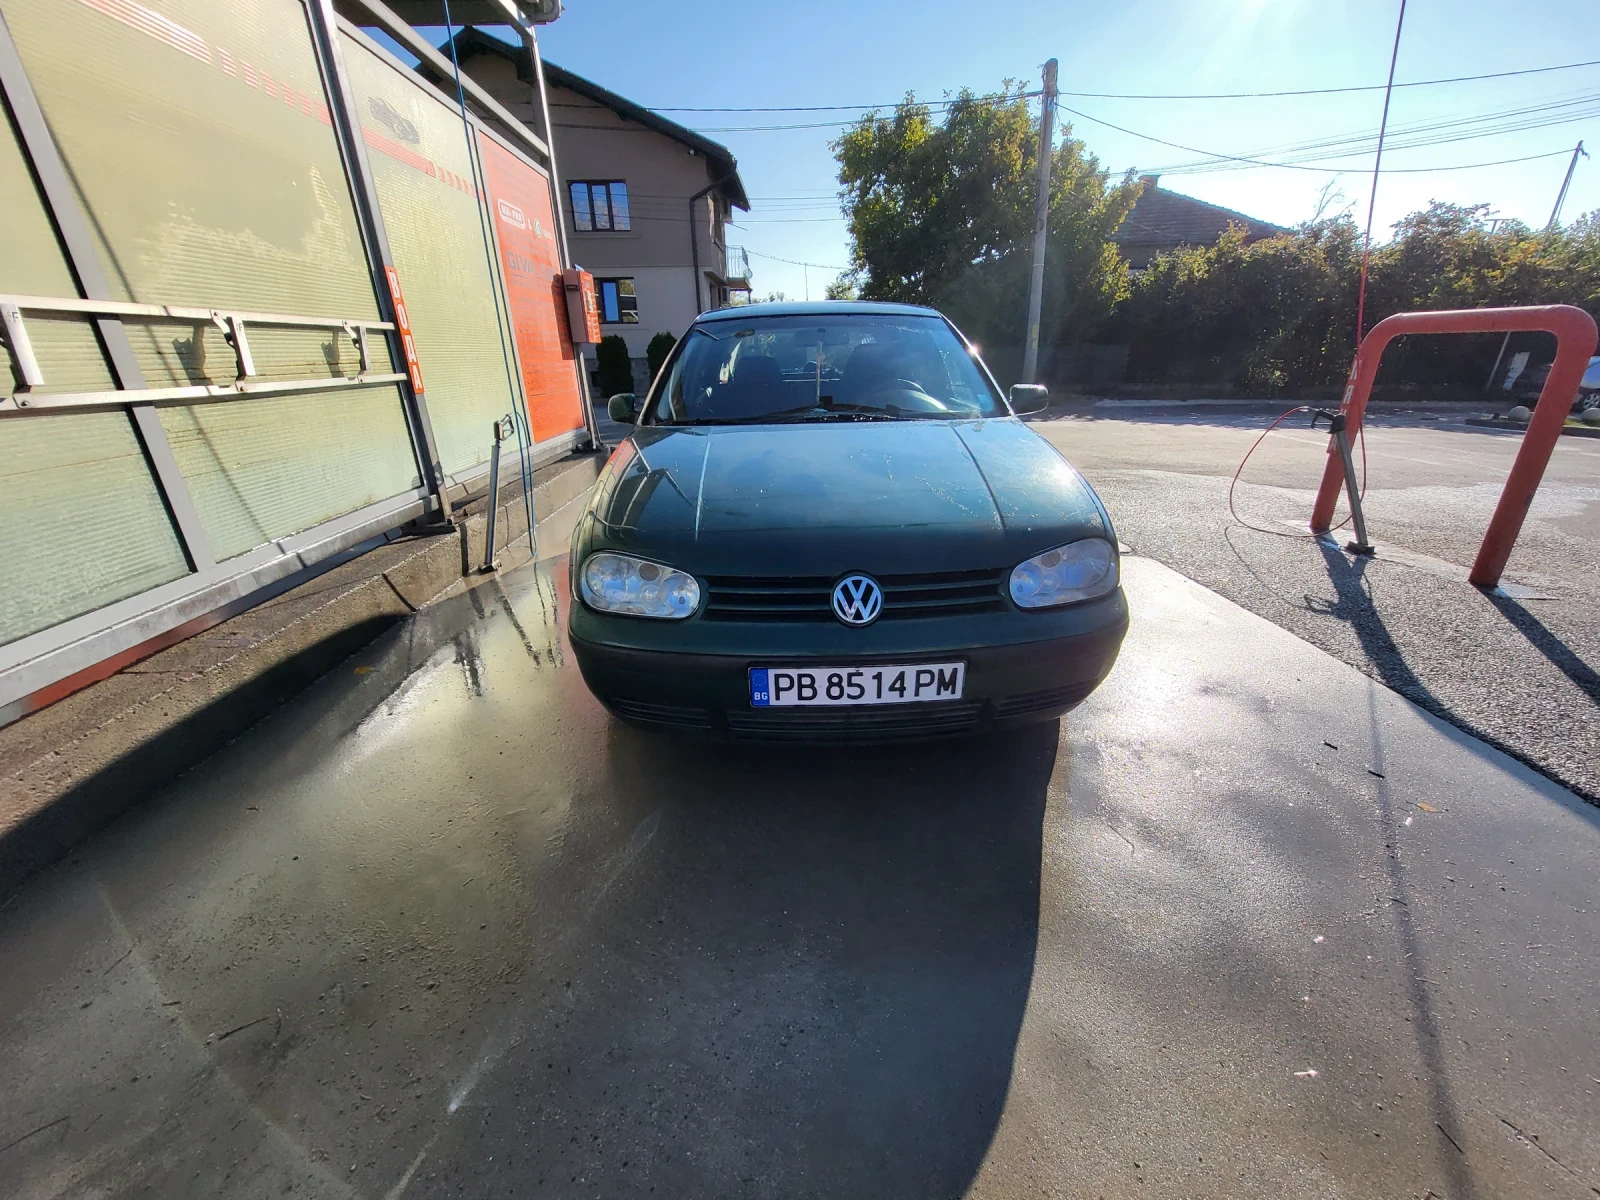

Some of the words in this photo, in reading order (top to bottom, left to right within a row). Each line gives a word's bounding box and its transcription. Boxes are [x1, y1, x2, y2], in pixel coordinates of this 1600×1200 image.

[754, 691, 768, 701] BG
[774, 673, 818, 701] PB
[825, 670, 907, 701] 8514
[914, 667, 958, 697] PM
